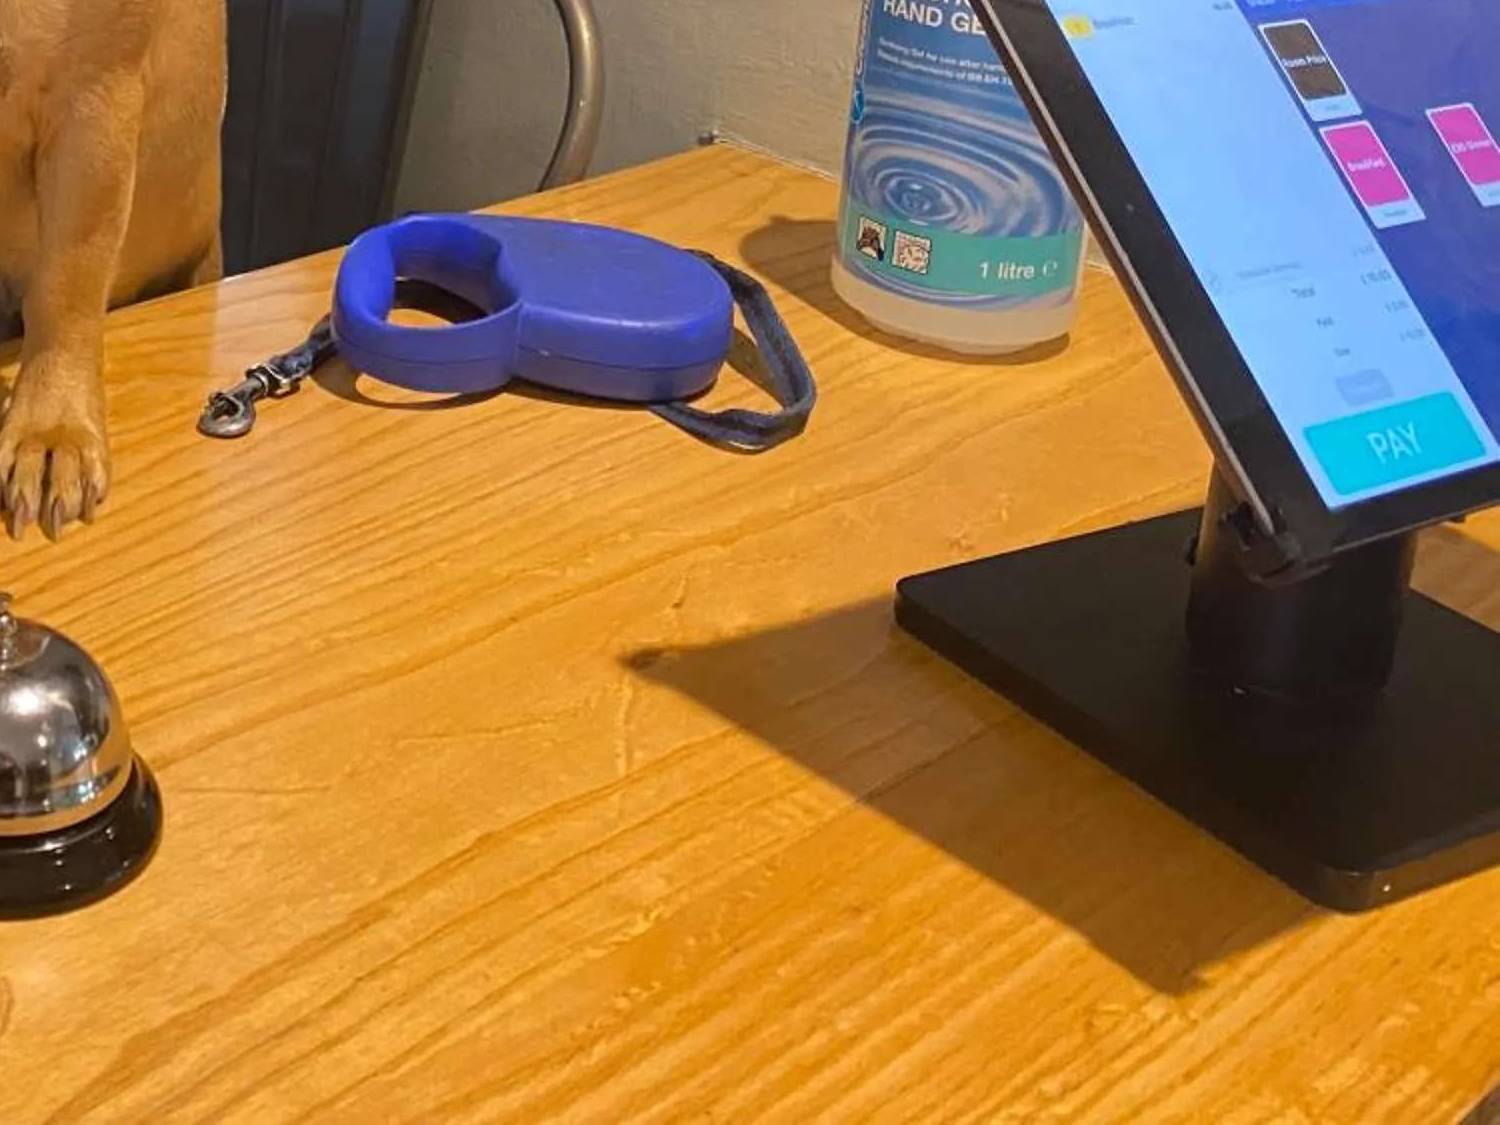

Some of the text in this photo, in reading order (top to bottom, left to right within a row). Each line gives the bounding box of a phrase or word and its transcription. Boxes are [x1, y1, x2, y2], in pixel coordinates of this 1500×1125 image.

[979, 261, 1035, 280] 1 litre
[1366, 421, 1422, 465] PAY
